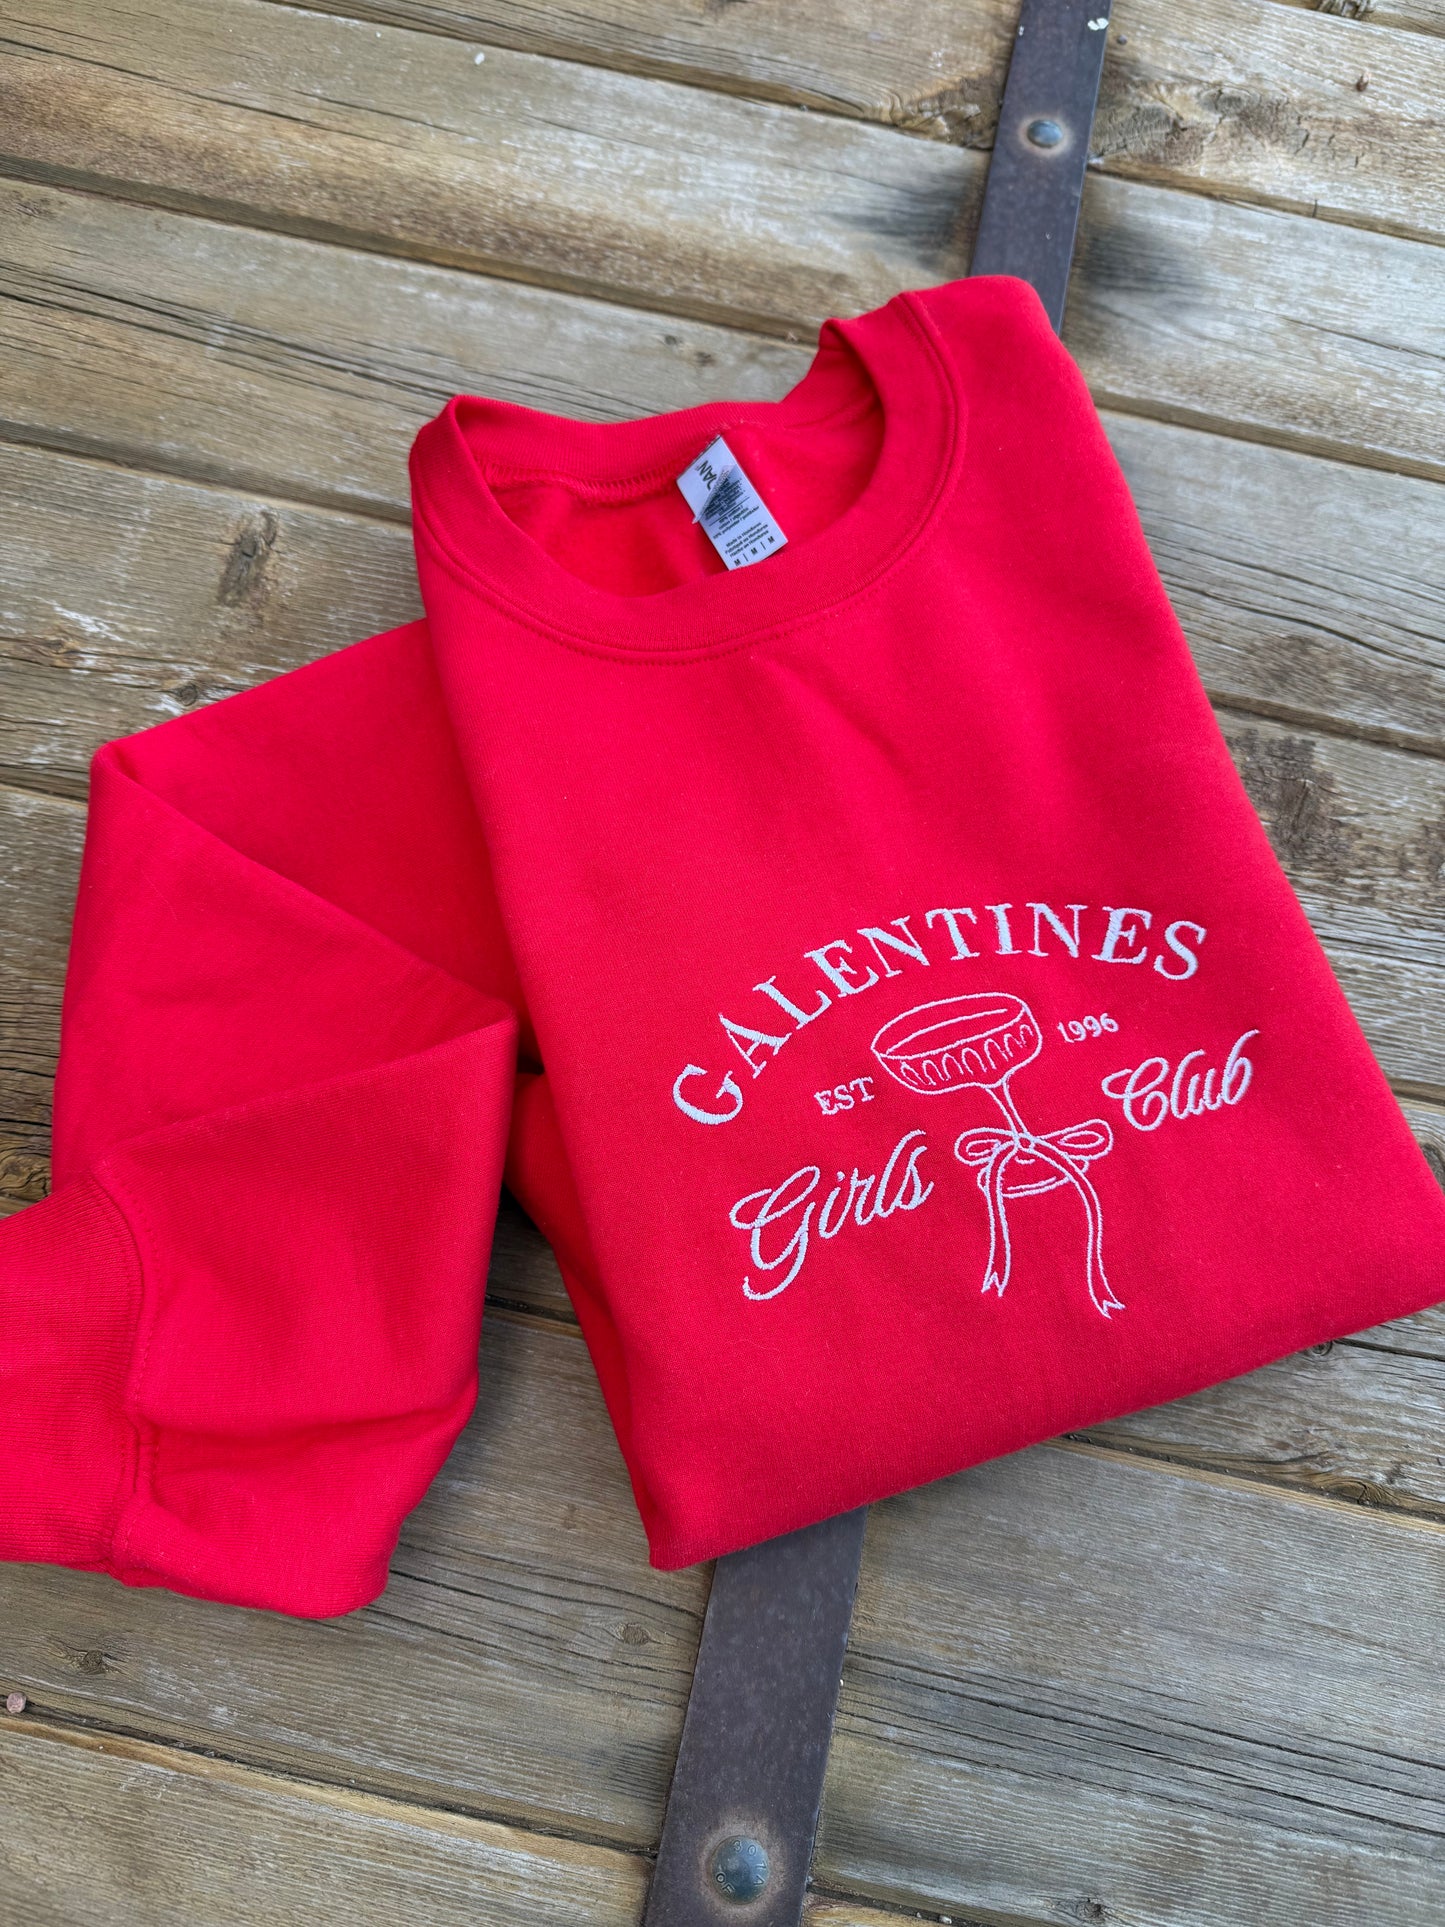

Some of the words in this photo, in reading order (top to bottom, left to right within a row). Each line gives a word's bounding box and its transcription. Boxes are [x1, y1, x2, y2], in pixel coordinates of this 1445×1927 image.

[742, 522, 762, 537] Honduras
[748, 523, 769, 539] Honduras
[748, 529, 769, 545] Honduras
[734, 558, 741, 567] M
[750, 547, 759, 555] M
[768, 535, 775, 543] M
[673, 903, 1206, 1125] GALENTINES
[814, 1077, 874, 1115] EST
[1057, 1013, 1118, 1043] 1996
[729, 1129, 934, 1300] Girls
[1101, 1029, 1259, 1131] Club
